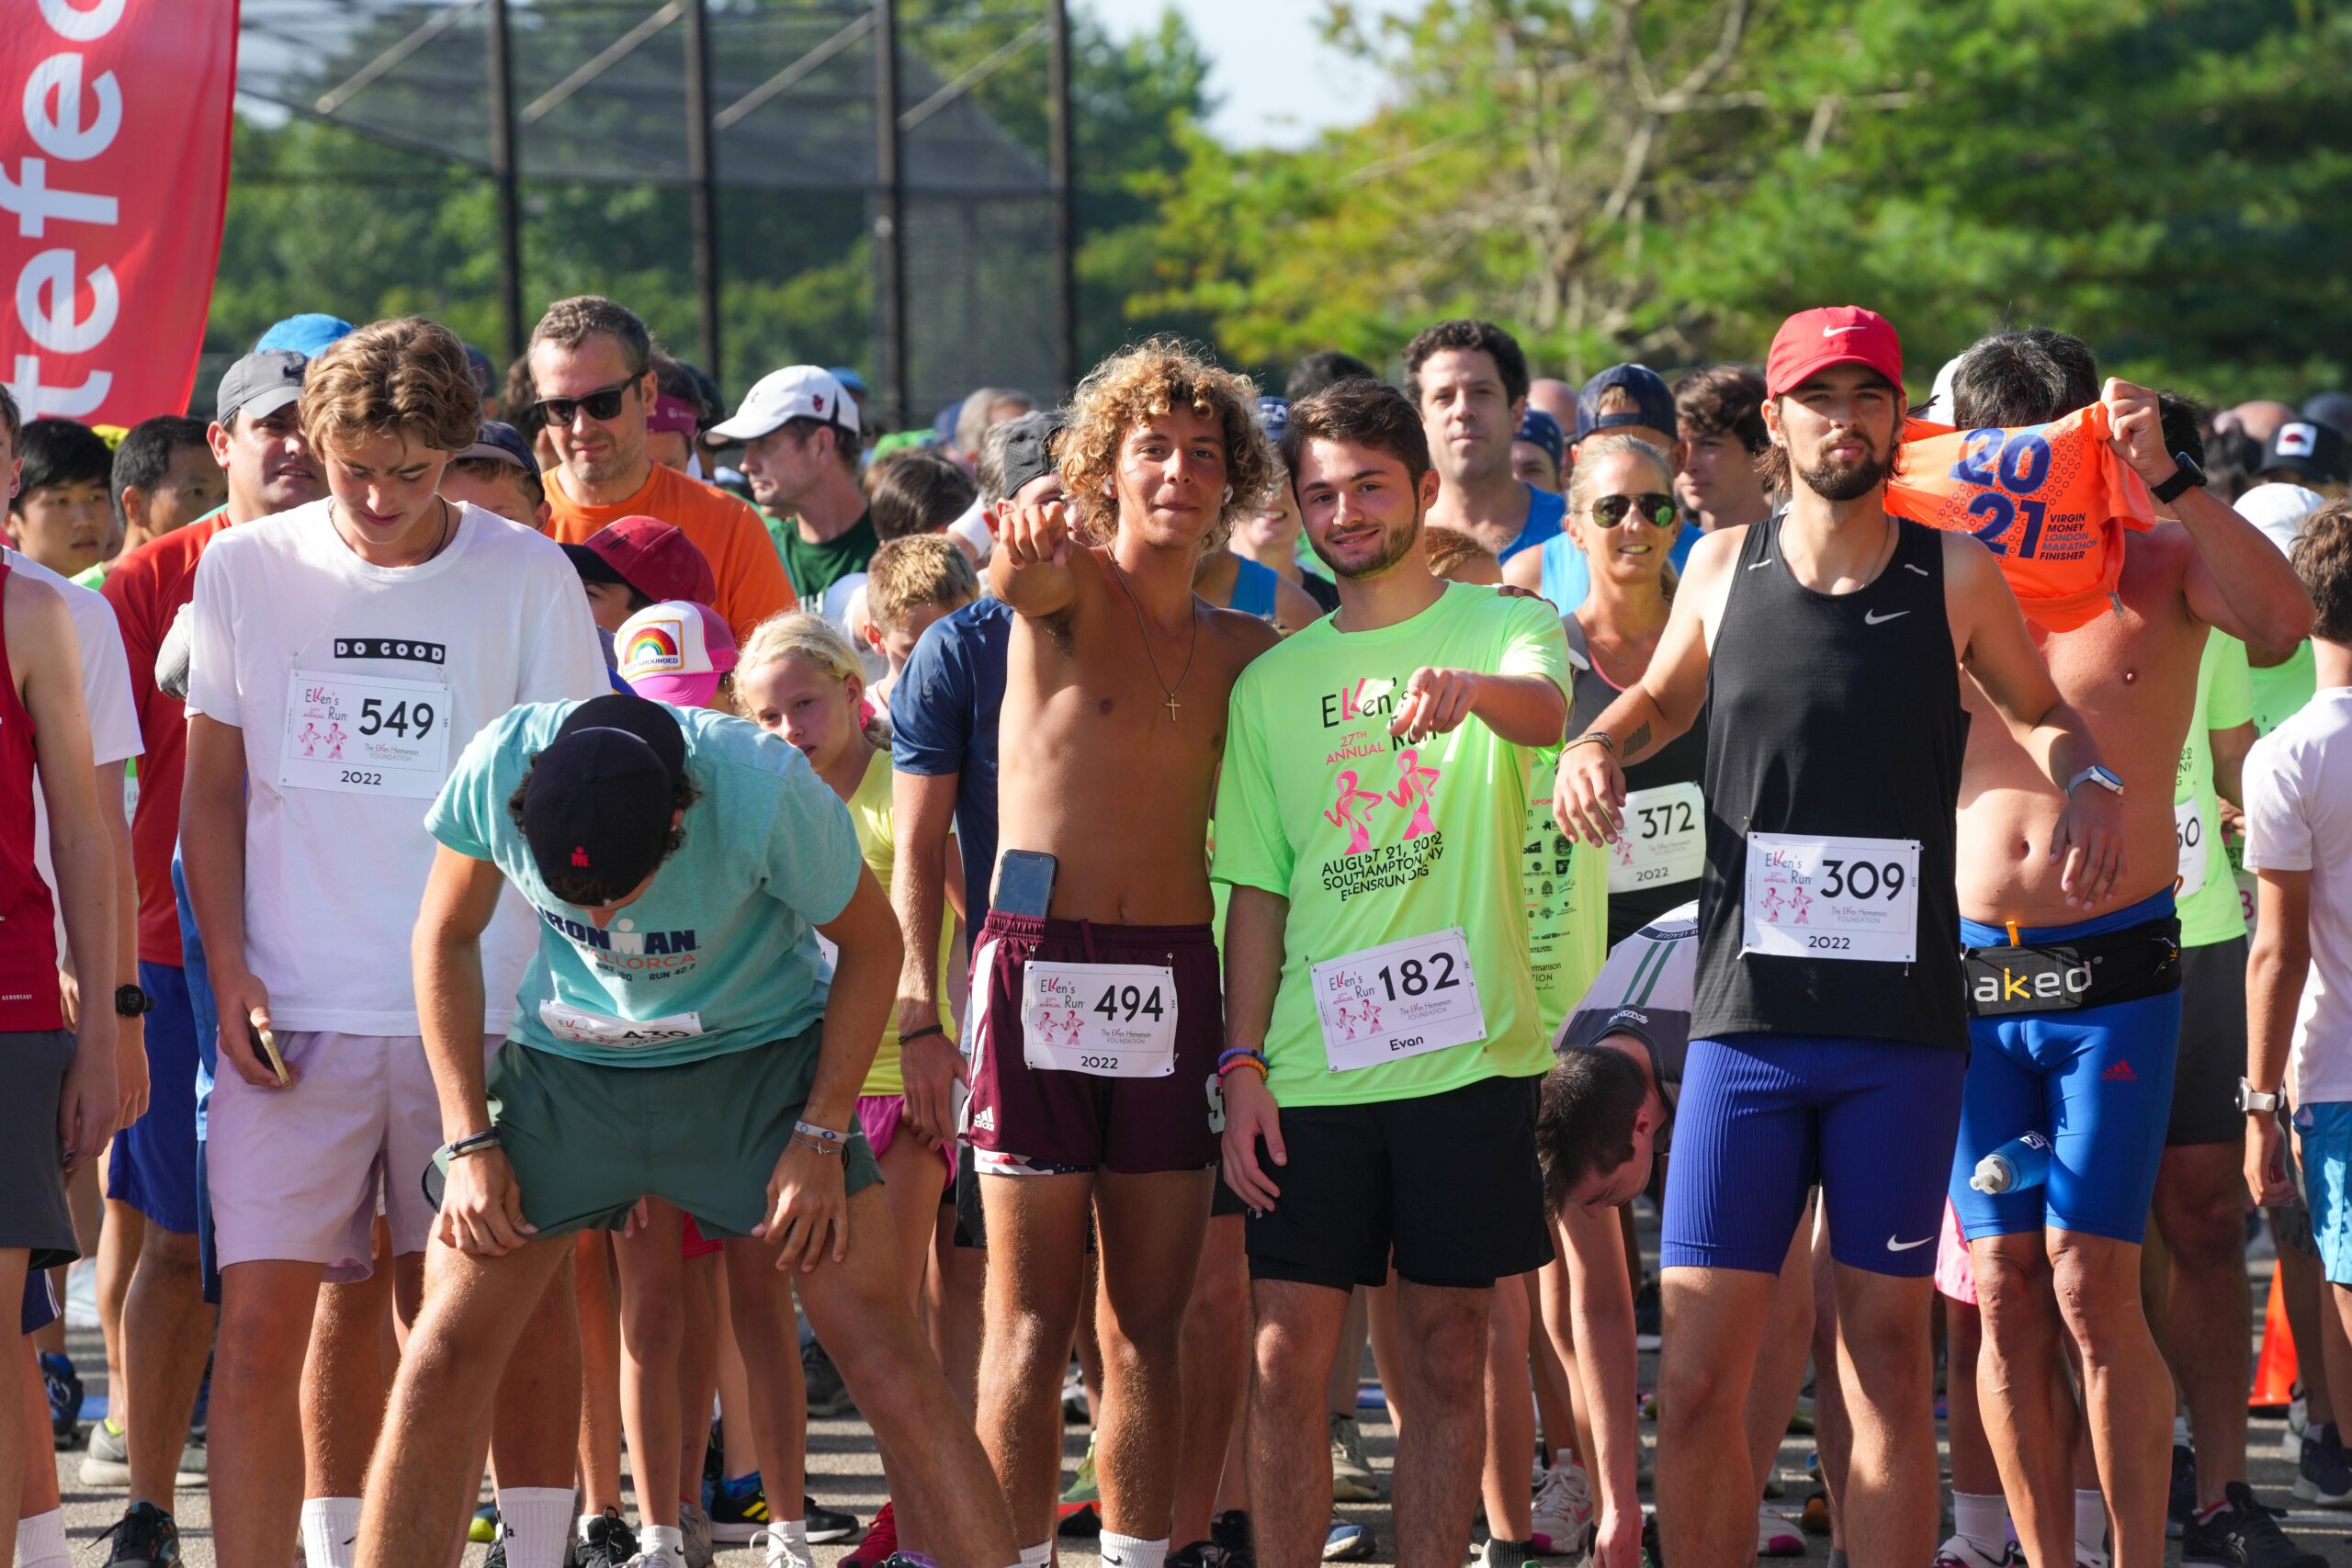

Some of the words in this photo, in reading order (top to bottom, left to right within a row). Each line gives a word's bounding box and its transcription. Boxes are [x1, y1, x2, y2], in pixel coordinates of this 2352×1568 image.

[1949, 427, 2052, 494] 20
[1967, 491, 2048, 559] 21
[2050, 513, 2086, 524] VIRGIN
[2047, 523, 2086, 533] MONEY
[2041, 539, 2098, 551] MARATHON
[2044, 532, 2088, 542] LONDON
[2039, 550, 2086, 560] FINISHER
[336, 641, 367, 656] DO
[380, 642, 443, 661] GOOD
[328, 705, 346, 721] Run
[358, 698, 434, 740] 549
[1340, 730, 1368, 748] 27TH
[370, 752, 413, 761] FOUNDATION
[1326, 741, 1386, 765] ANNUAL
[341, 770, 382, 785] 2022
[1637, 801, 1695, 840] 372
[1385, 843, 1408, 860] 21,
[1636, 866, 1669, 882] 2022
[1792, 869, 1811, 885] Run
[1820, 859, 1905, 902] 309
[1838, 915, 1881, 924] FOUNDATION
[1808, 935, 1850, 950] 2022
[649, 971, 671, 981] RUN
[1378, 952, 1460, 1001] 182
[1963, 957, 2093, 1003] aked
[1355, 985, 1375, 999] Run
[1065, 994, 1084, 1009] Run
[1093, 985, 1164, 1023] 494
[1408, 1007, 1448, 1021] FOUNDATION
[1389, 1036, 1424, 1052] Evan
[1080, 1055, 1118, 1069] 2022
